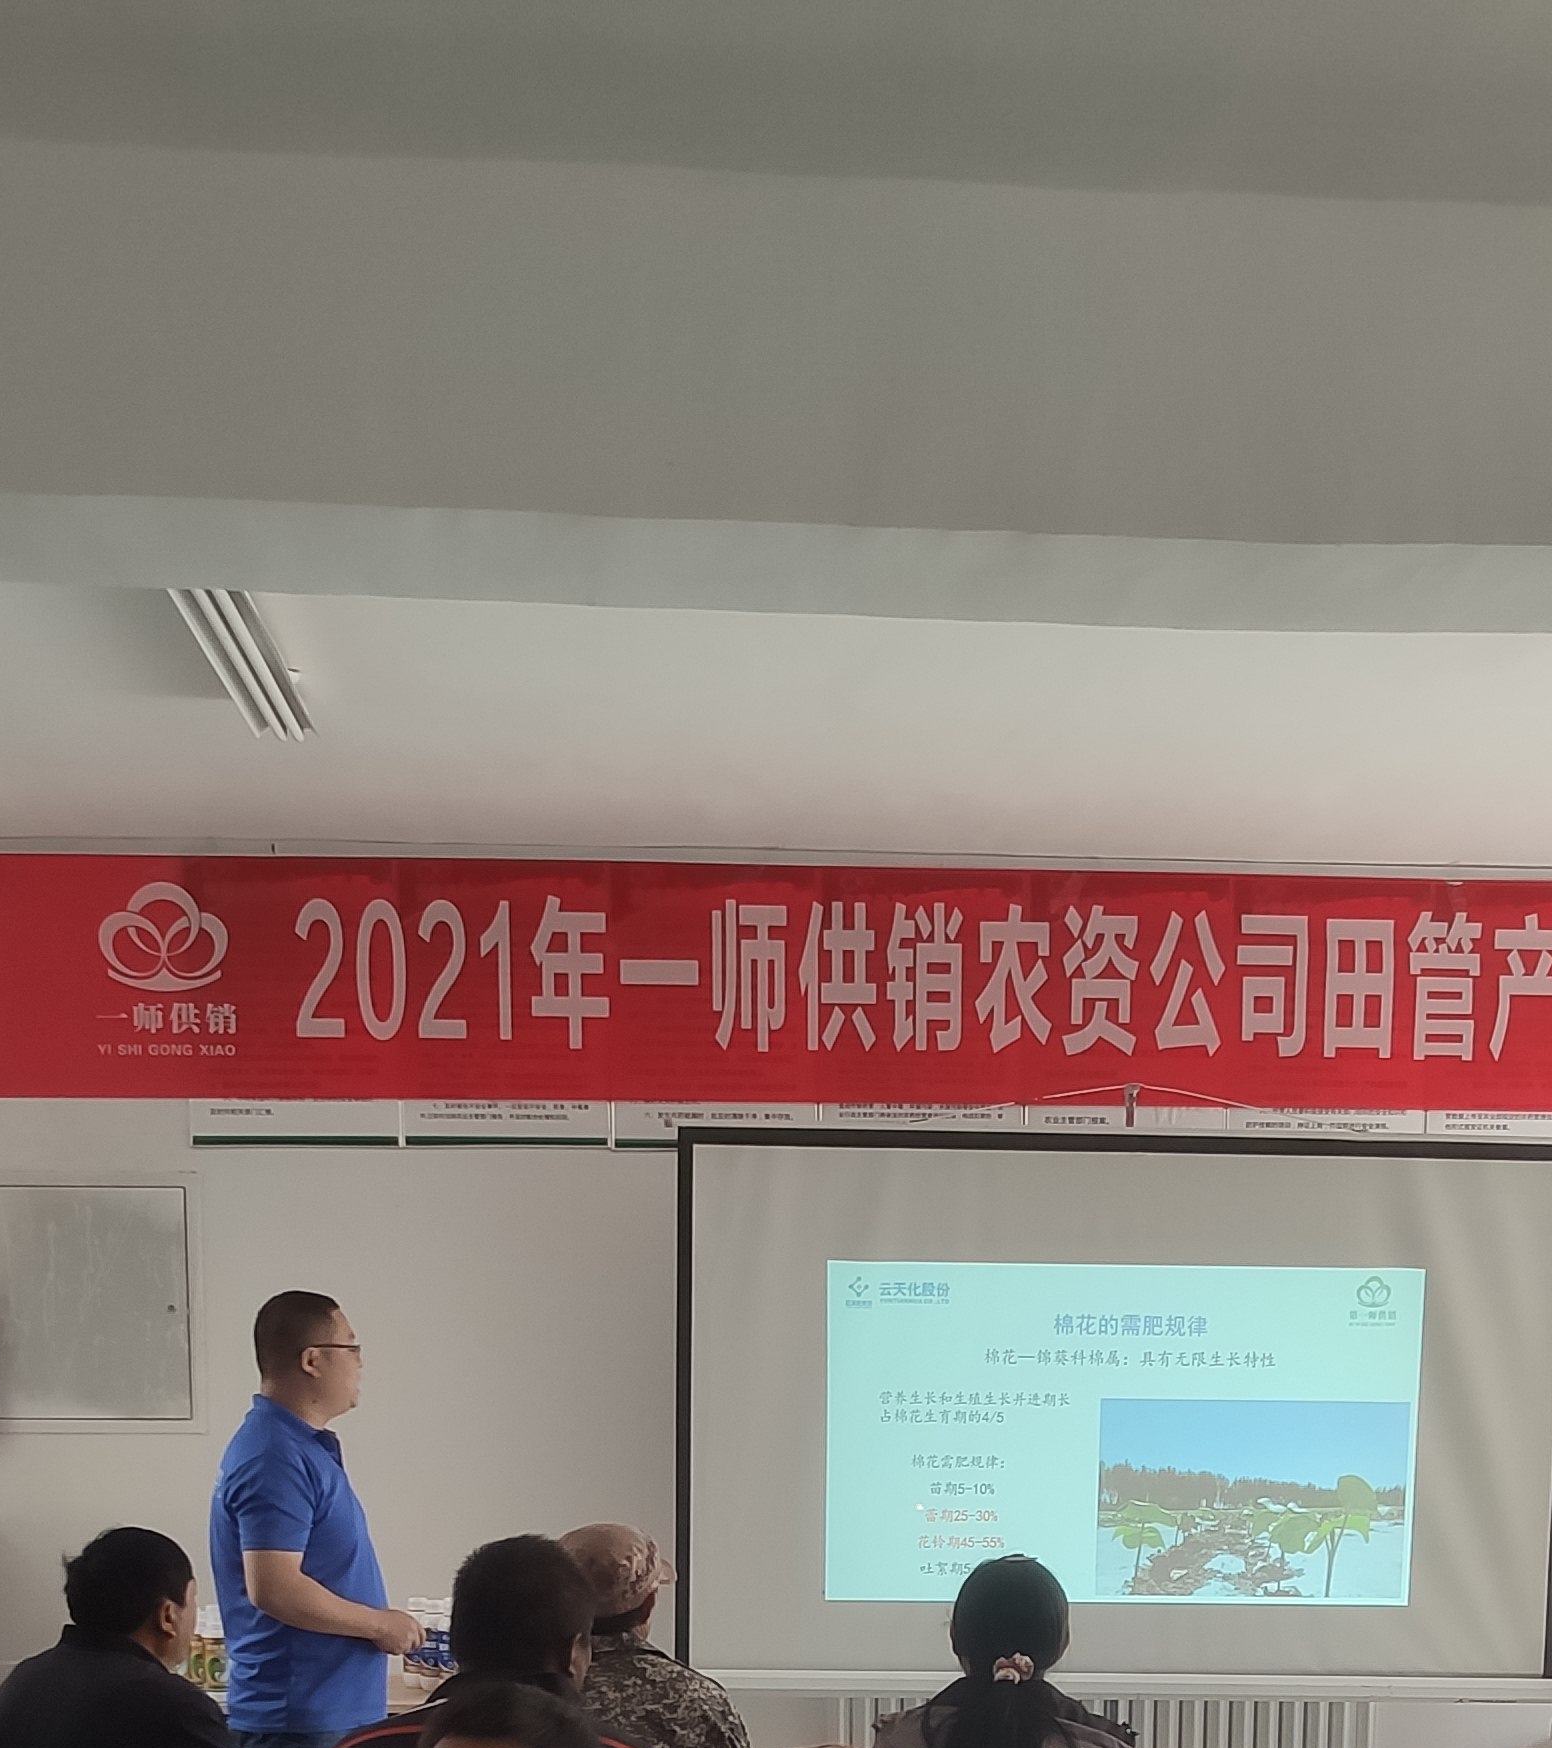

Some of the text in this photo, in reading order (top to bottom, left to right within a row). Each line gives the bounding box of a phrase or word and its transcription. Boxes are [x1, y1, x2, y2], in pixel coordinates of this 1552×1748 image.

[96, 1002, 237, 1034] 一师供销
[98, 1044, 236, 1056] YI SHI GONG XIAO
[878, 1282, 950, 1297] 云天化股份
[1053, 1313, 1209, 1337] 棉花的需肥规律
[879, 1390, 1071, 1407] 营养生长和生殖生长并进期长
[879, 1409, 1005, 1425] 占棉花生育期的4/5
[929, 1482, 996, 1496] 苗期5-10%
[924, 1508, 999, 1523] 蕾期25-30%
[917, 1535, 1006, 1550] 花铃期45-55%
